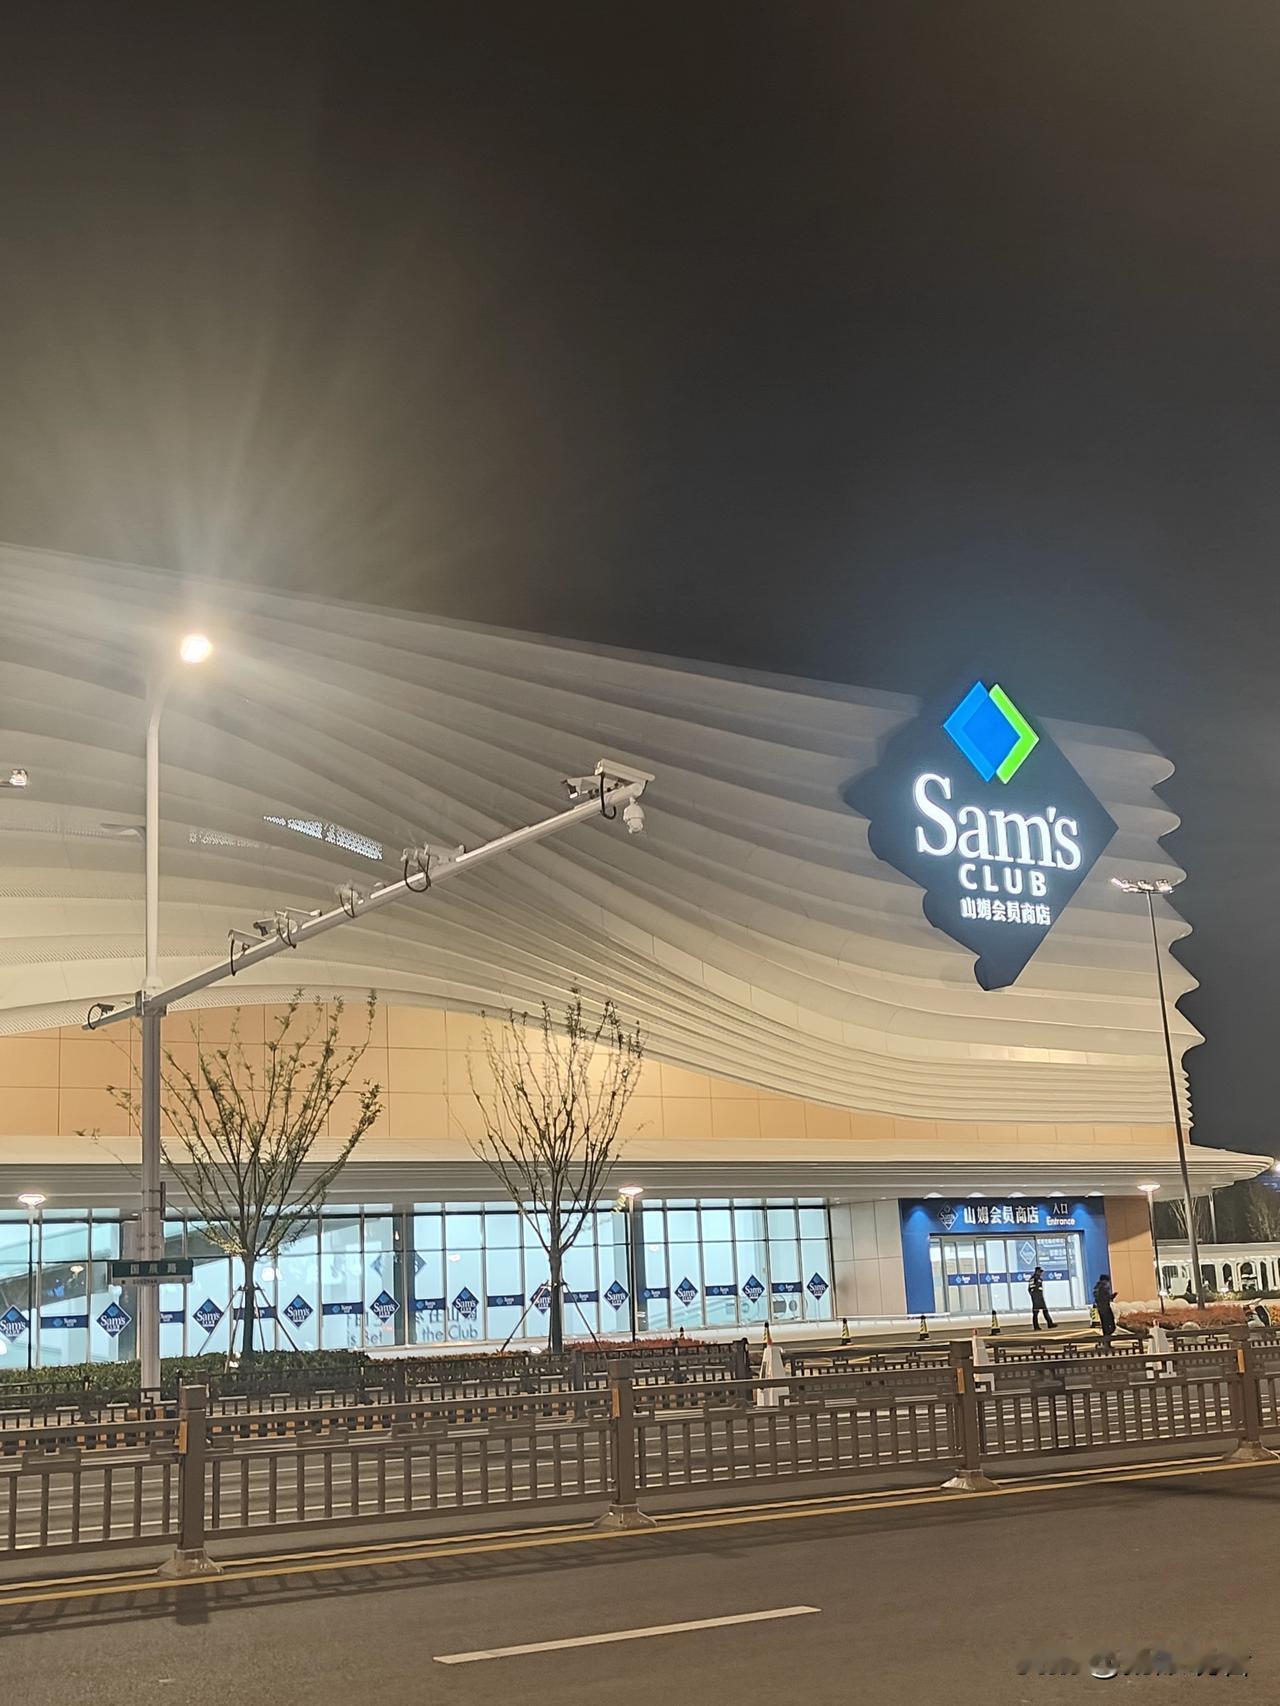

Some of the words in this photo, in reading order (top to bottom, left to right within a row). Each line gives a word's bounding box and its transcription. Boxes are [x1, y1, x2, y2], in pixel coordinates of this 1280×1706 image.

[914, 773, 1083, 871] Sam's
[958, 863, 1049, 898] CLUB
[960, 896, 1051, 926] 山姆会员商店
[963, 1205, 1040, 1225] 山姆会员商店
[1052, 1202, 1069, 1215] 入口
[1046, 1216, 1076, 1227] Entrance
[422, 1325, 444, 1341] the
[448, 1323, 478, 1340] Club
